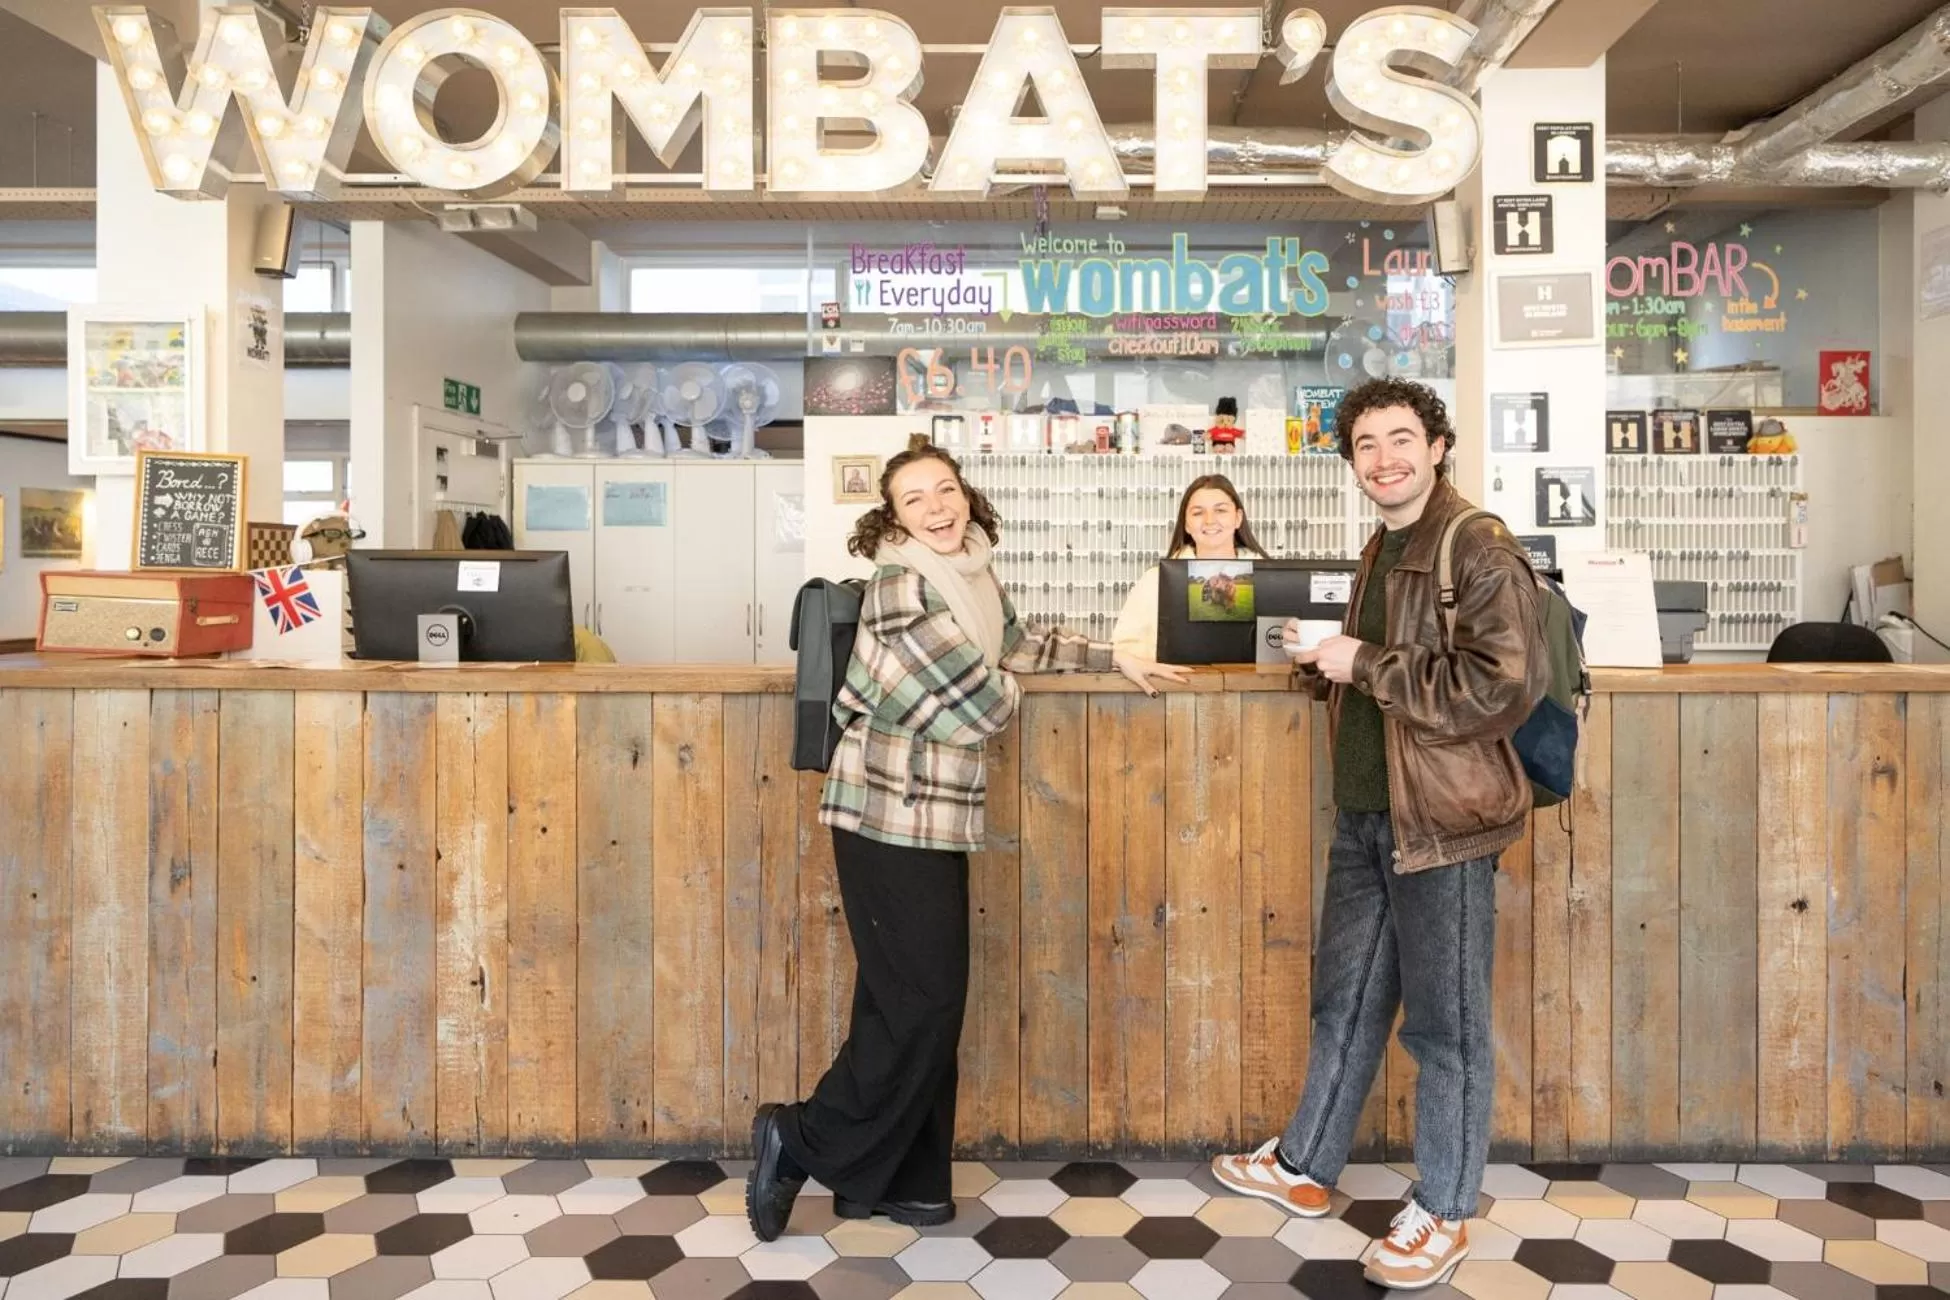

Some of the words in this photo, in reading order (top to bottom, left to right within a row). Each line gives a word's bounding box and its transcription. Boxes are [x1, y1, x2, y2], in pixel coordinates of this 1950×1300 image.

[92, 4, 1484, 206] WOMBAT'S
[1020, 232, 1097, 255] Welcome
[1106, 233, 1126, 255] to
[1018, 232, 1330, 318] wombat's
[879, 278, 992, 317] Everyday
[1144, 313, 1217, 335] password
[1296, 388, 1344, 400] WOMBAT
[173, 492, 206, 501] WHY
[208, 493, 235, 504] NOT
[173, 501, 223, 512] BORROW
[170, 510, 181, 520] A
[184, 510, 226, 523] GAME?
[1268, 633, 1284, 642] DEL
